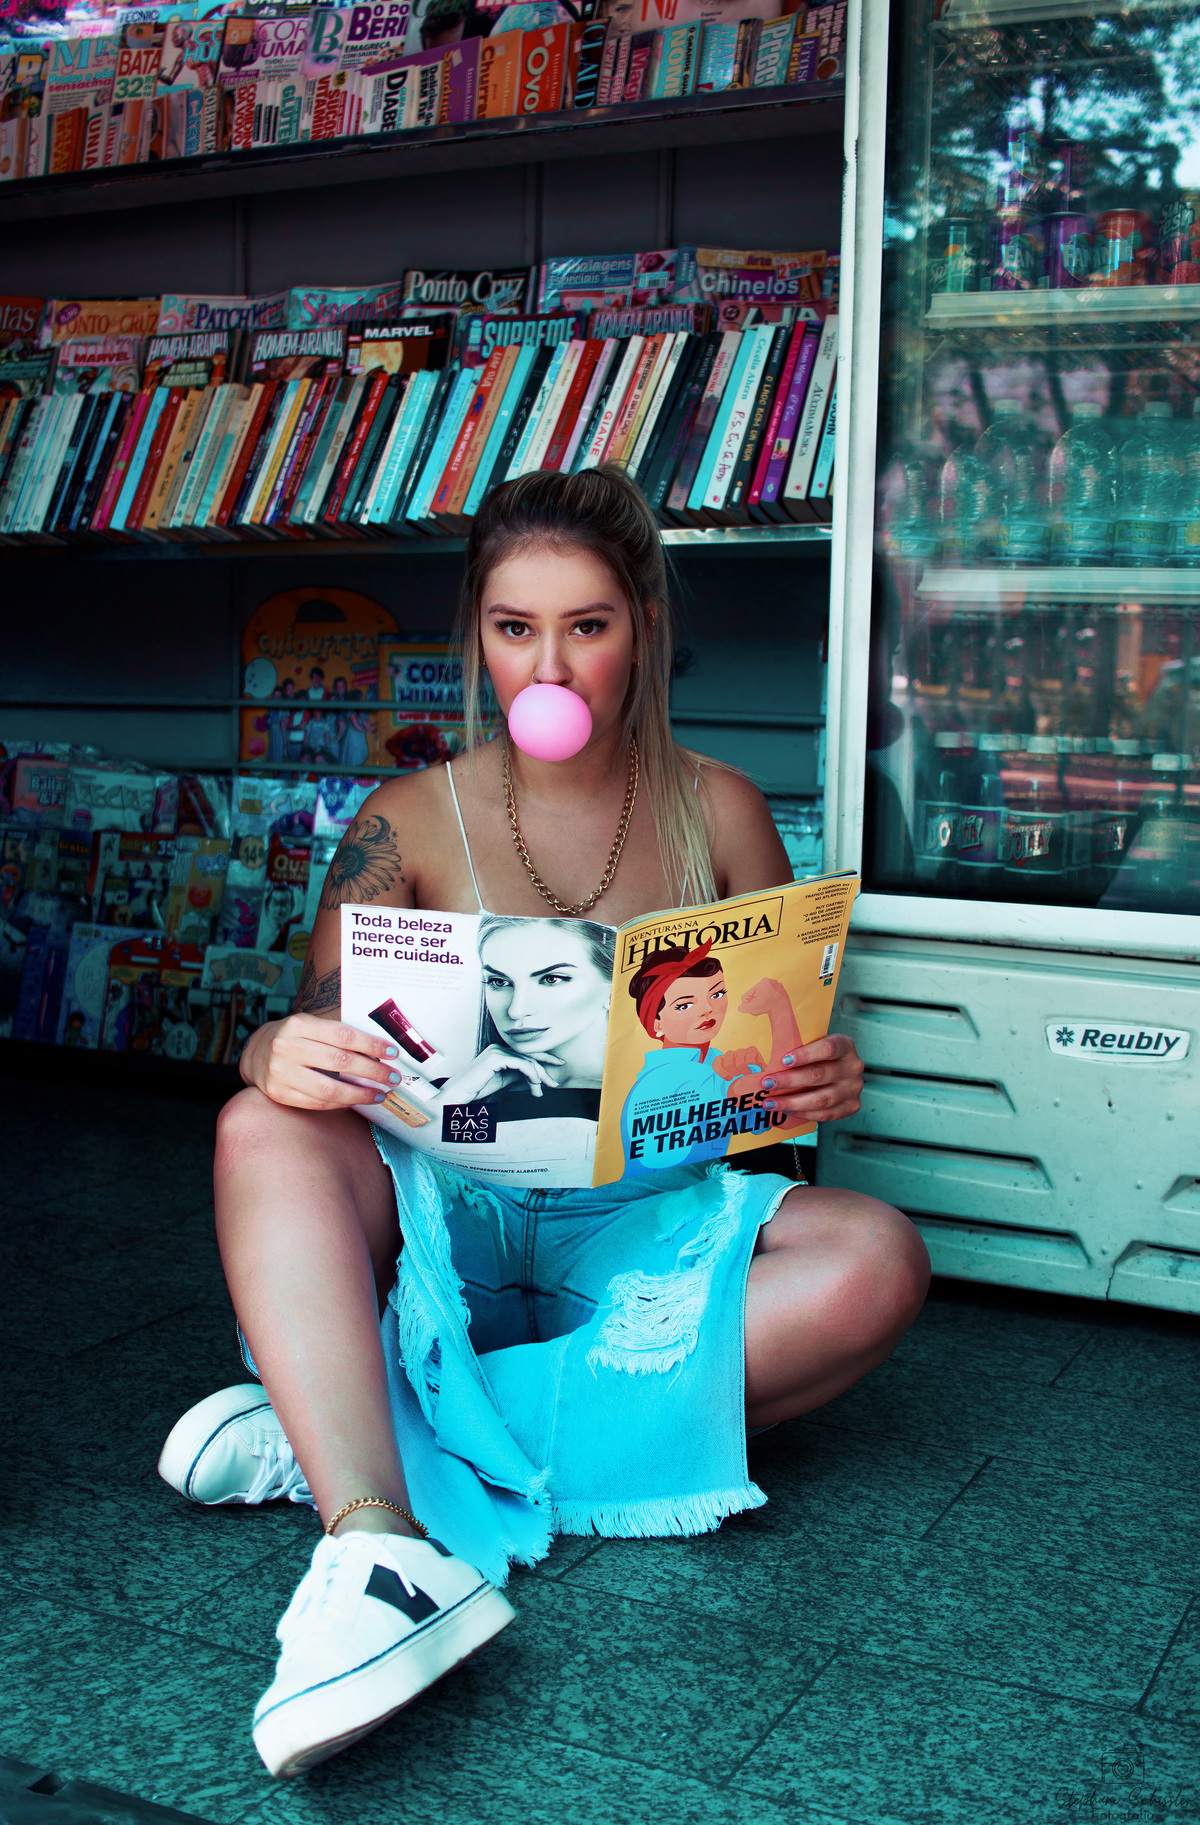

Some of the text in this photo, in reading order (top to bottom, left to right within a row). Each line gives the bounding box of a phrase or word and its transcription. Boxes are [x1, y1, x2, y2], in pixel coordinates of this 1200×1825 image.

[114, 77, 143, 98] 32
[523, 46, 549, 116] Ovo
[408, 270, 468, 302] Ponto
[701, 271, 800, 295] Chinelos
[364, 325, 435, 340] MARVEL
[592, 309, 696, 340] HOMEM-ARANHA
[251, 329, 343, 363] HOMEM-ARANHA
[648, 341, 659, 360] JAMES
[74, 352, 131, 363] MARVEL
[793, 343, 813, 386] Susan Wiggs
[481, 370, 497, 388] DIA
[574, 349, 594, 395] DAN BROWN
[637, 359, 653, 391] PATTERSON
[741, 337, 767, 401] Cecelia Ahern
[758, 383, 772, 406] LADO
[752, 406, 765, 427] BOM
[590, 410, 614, 457] GIANE
[748, 429, 759, 442] DA
[451, 421, 475, 472] DAVID NICHOLLS
[742, 442, 755, 462] VIDA
[407, 662, 467, 684] CORP
[805, 890, 825, 899] TRÁFICO
[822, 891, 848, 900] ATLÂNTICO
[826, 900, 846, 908] CASTRO:
[821, 909, 844, 919] MODERNO
[825, 904, 845, 913] JANEIRO
[351, 913, 453, 934] Toda beleza
[629, 919, 699, 944] AVENTURAS NA
[801, 928, 821, 937] BATALHA
[820, 923, 841, 932] MILENAR
[352, 930, 447, 949] merece ser
[626, 913, 775, 966] HISTÓRIA
[803, 932, 839, 946] INDEPENDÊNCIA
[352, 943, 465, 966] bem cuidada.
[1080, 1029, 1181, 1057] Reubly
[631, 1089, 771, 1138] MULHERES
[629, 1108, 789, 1160] E TRABALHO
[469, 1165, 516, 1174] REPRESENTANTE
